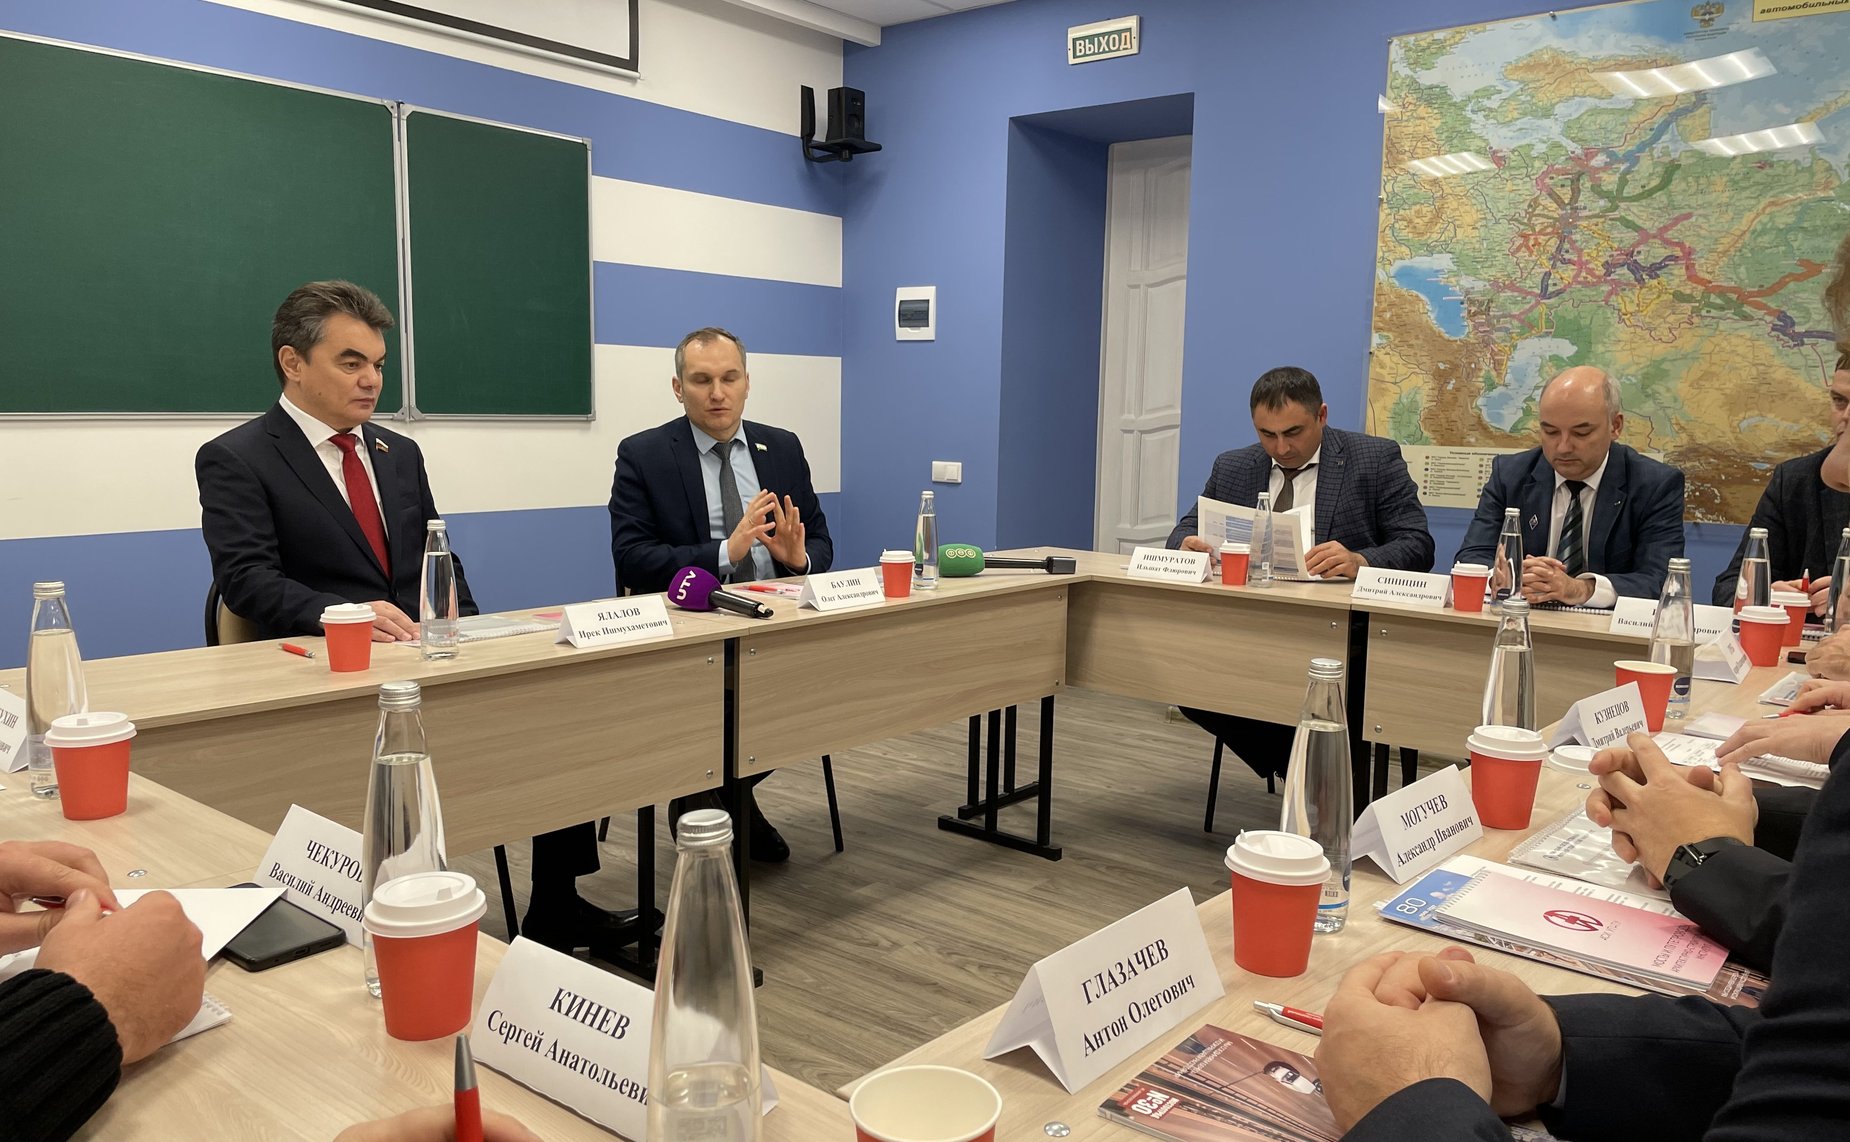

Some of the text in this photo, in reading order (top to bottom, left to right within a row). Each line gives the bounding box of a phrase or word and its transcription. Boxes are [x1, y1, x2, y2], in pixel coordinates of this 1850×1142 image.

[1075, 31, 1132, 56] ВЫХОД
[1143, 554, 1196, 565] ИШМУРАТОВ
[676, 570, 697, 601] UTV
[820, 589, 879, 603] Олег Александрович
[830, 578, 861, 589] БАУЛИН
[1358, 586, 1442, 600] Дмитрий Александрович
[597, 607, 641, 621] ЯЛАЛОВ
[578, 620, 668, 640] Ирек Ишмухаметович
[1594, 700, 1630, 725] КУЗНЕЦОВ
[1400, 794, 1448, 830] МОГУЧЕВ
[1396, 816, 1474, 867] Александр Иванович
[268, 862, 316, 896] Василий
[1396, 897, 1427, 915] 80
[1081, 939, 1169, 1005] ГЛАЗАЧЕВ
[547, 987, 631, 1040] КИНЕВ
[1083, 1015, 1129, 1058] Антон
[1128, 974, 1196, 1024] Олегович
[487, 1009, 648, 1106] Сергей Анатольеви
